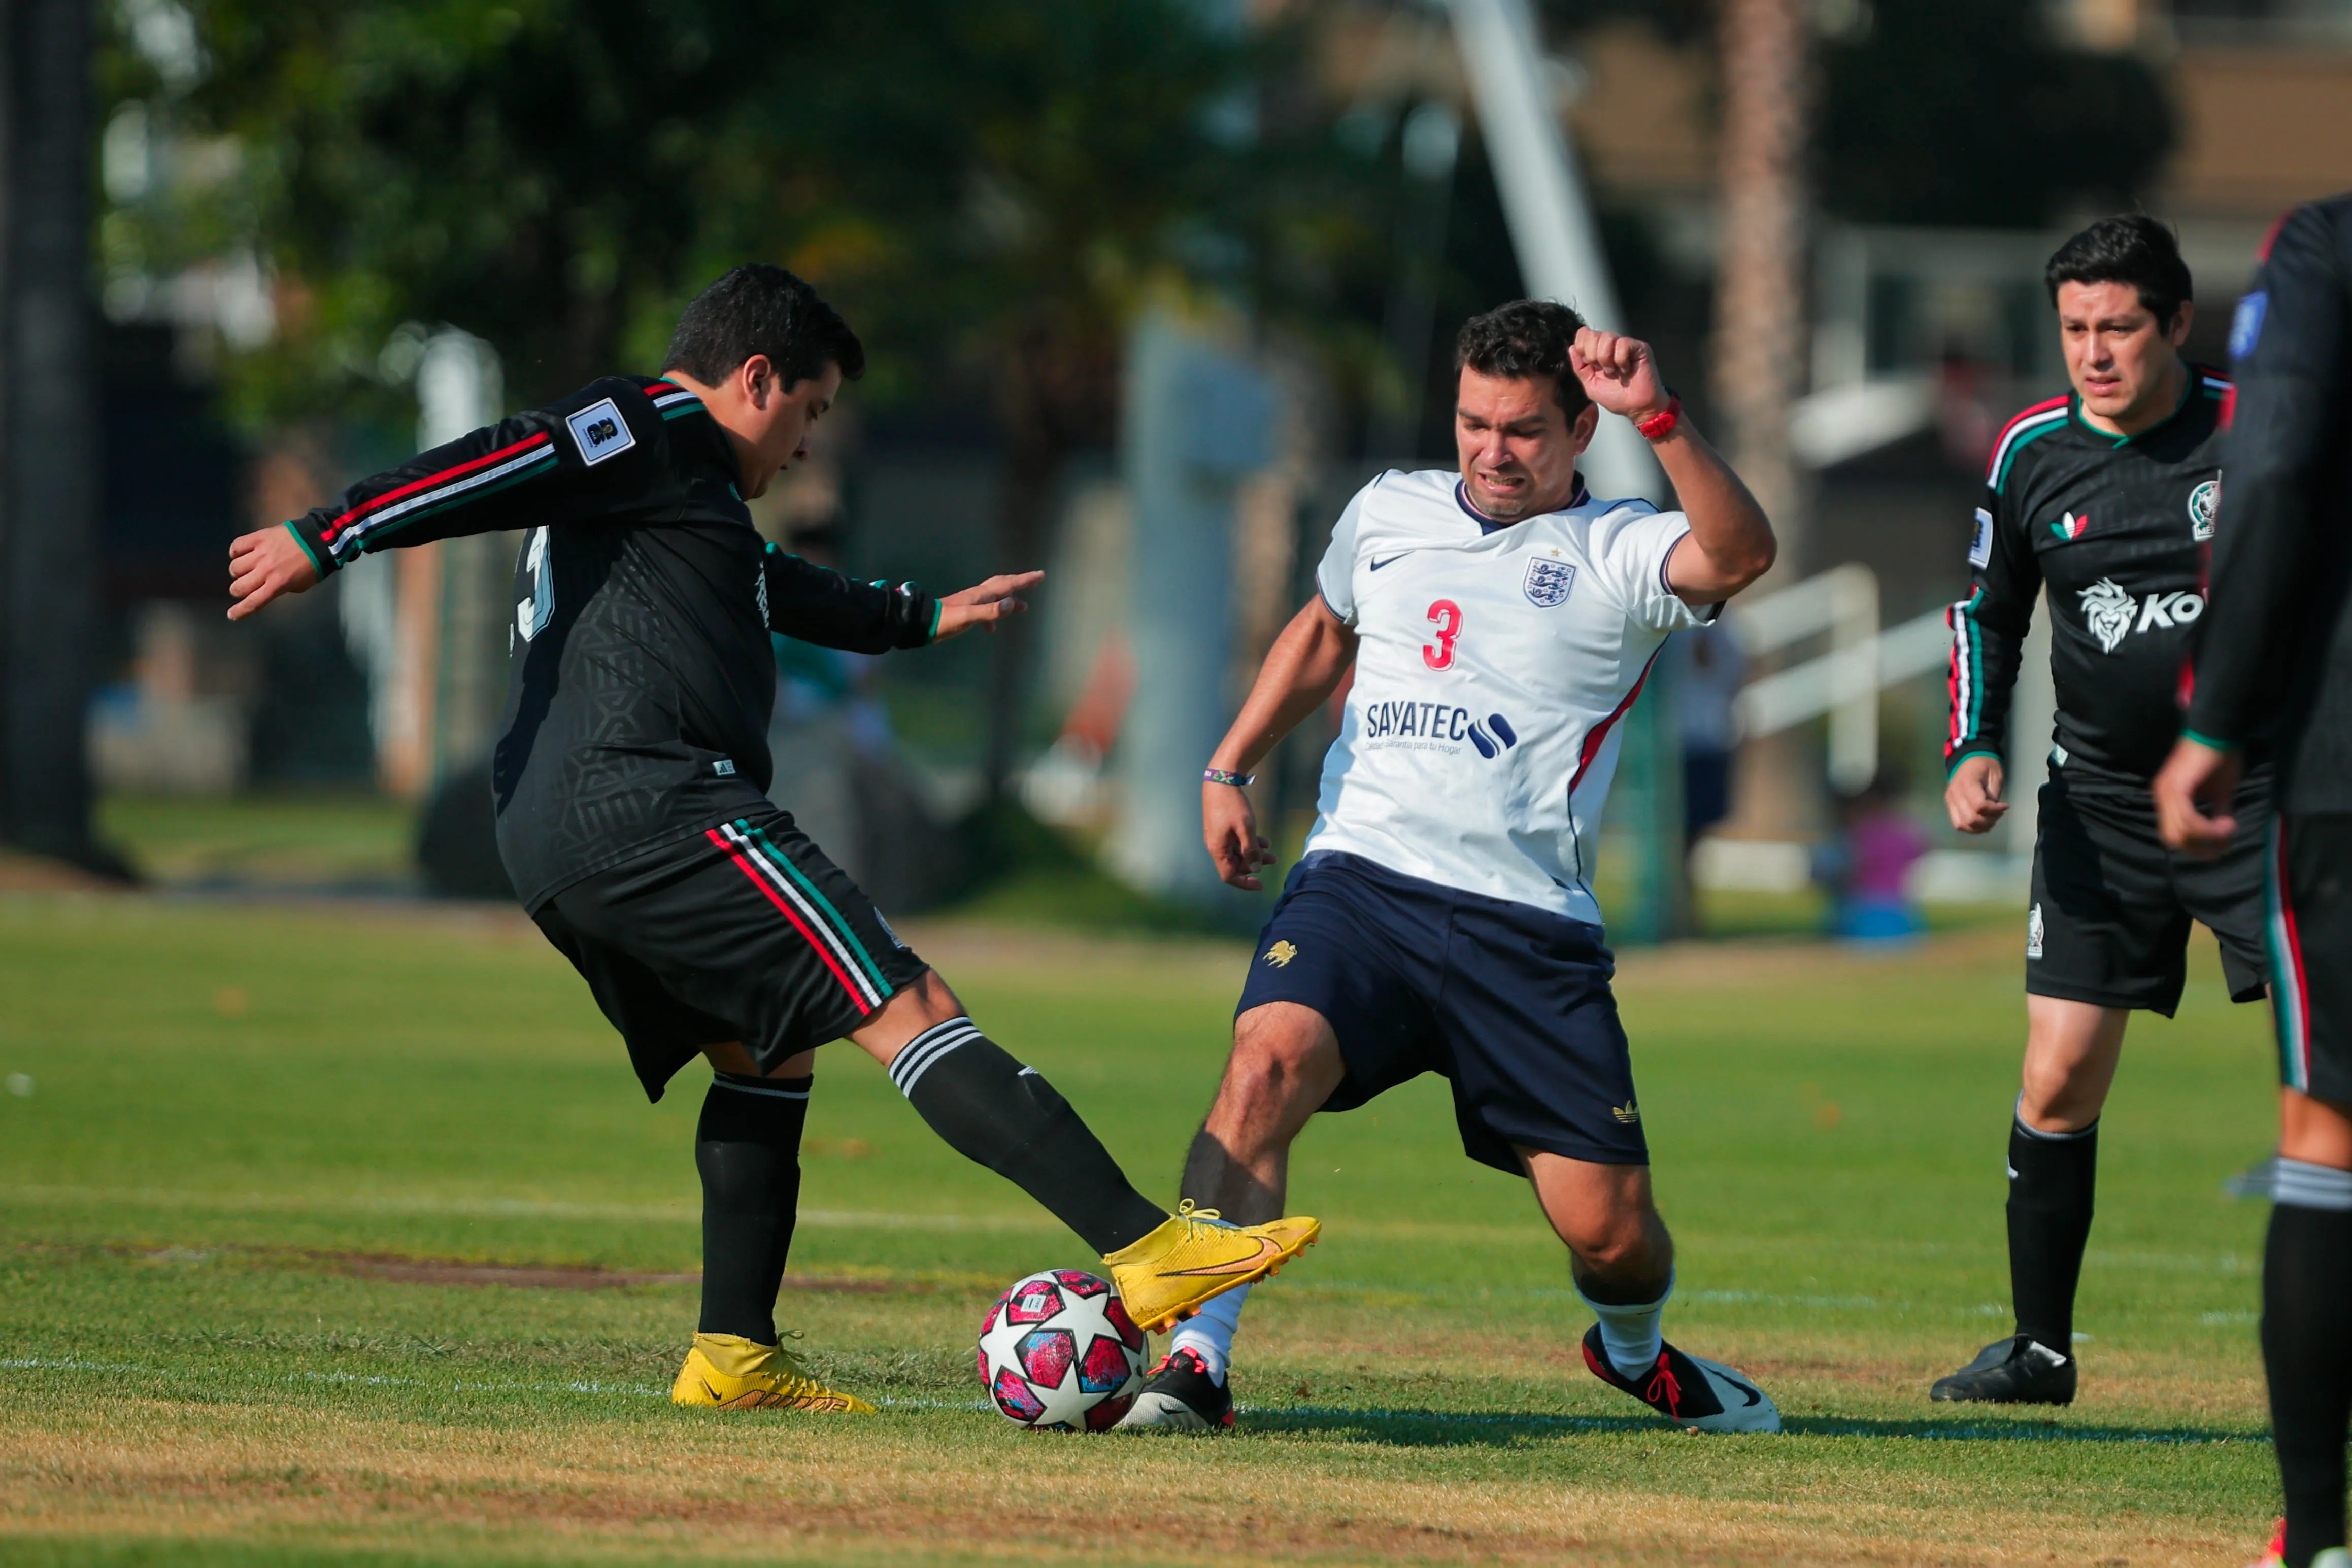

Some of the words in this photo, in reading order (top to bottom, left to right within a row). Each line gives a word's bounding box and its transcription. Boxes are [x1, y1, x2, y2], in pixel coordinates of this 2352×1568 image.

[2135, 587, 2208, 634] KO
[1423, 599, 1463, 672] 3
[1367, 701, 1468, 741] SAYATEC
[1413, 742, 1428, 751] para
[1430, 742, 1437, 751] tu
[1438, 742, 1462, 755] Hogar
